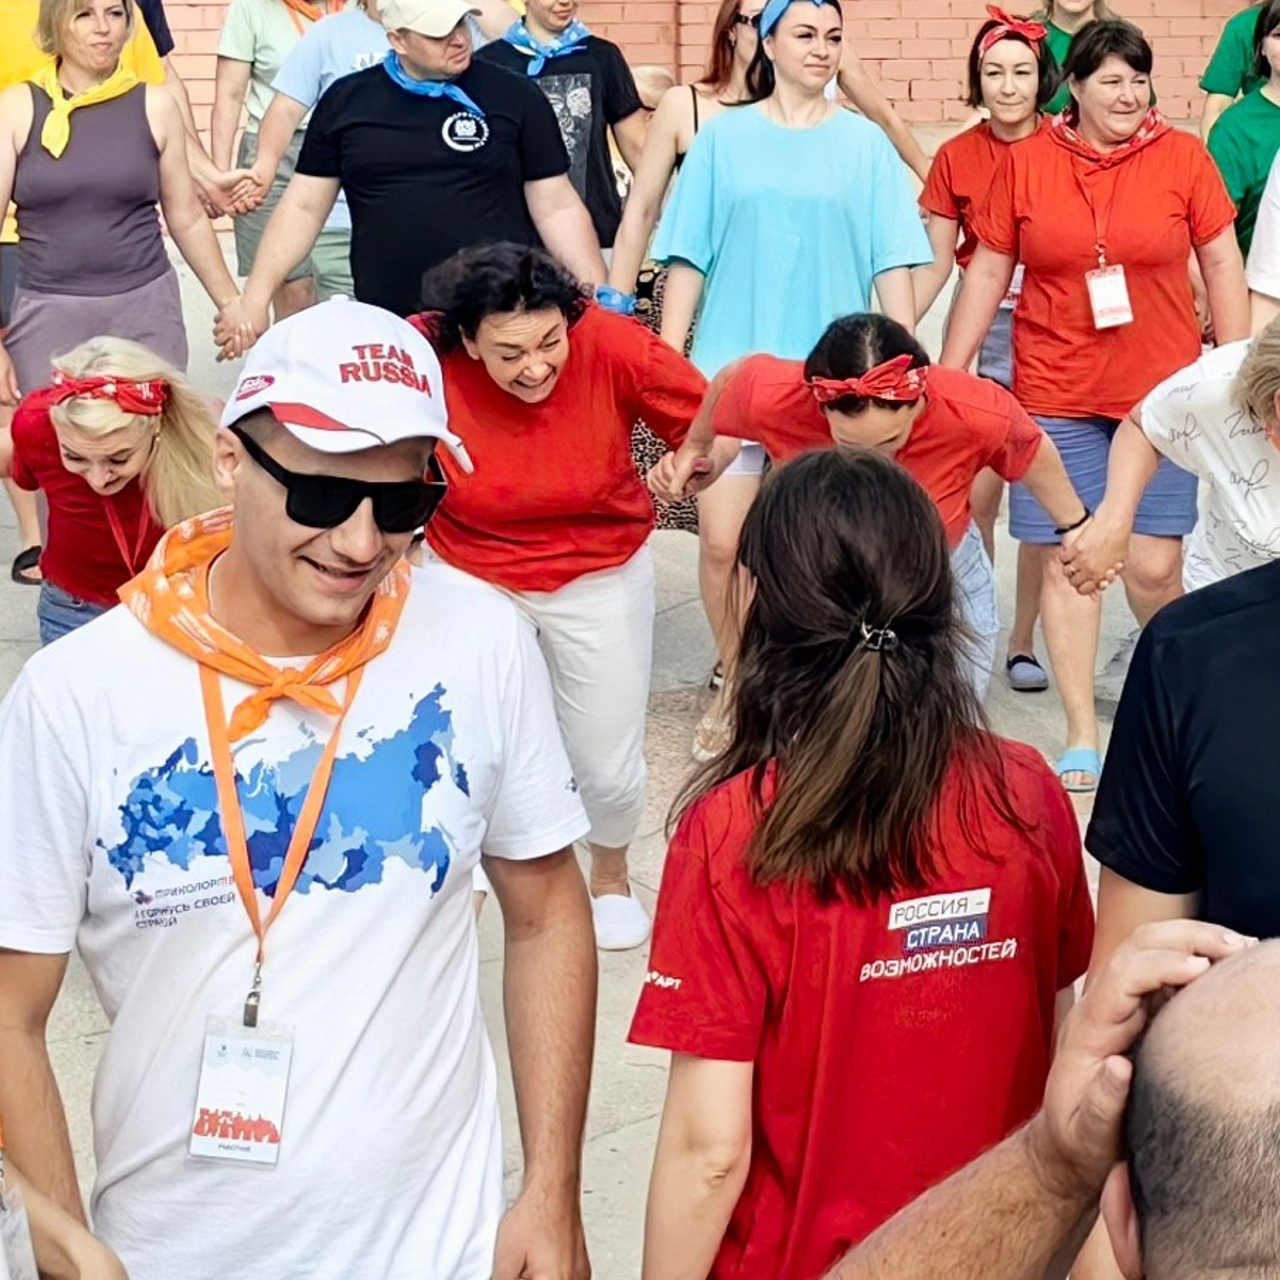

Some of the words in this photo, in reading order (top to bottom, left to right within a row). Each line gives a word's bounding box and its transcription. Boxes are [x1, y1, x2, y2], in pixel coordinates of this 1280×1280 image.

[339, 362, 432, 399] RUSSIA
[894, 897, 969, 925] РОССИЯ
[906, 920, 980, 951] СТРАНА
[859, 937, 1018, 983] ВОЗМОЖНОСТЕЙ
